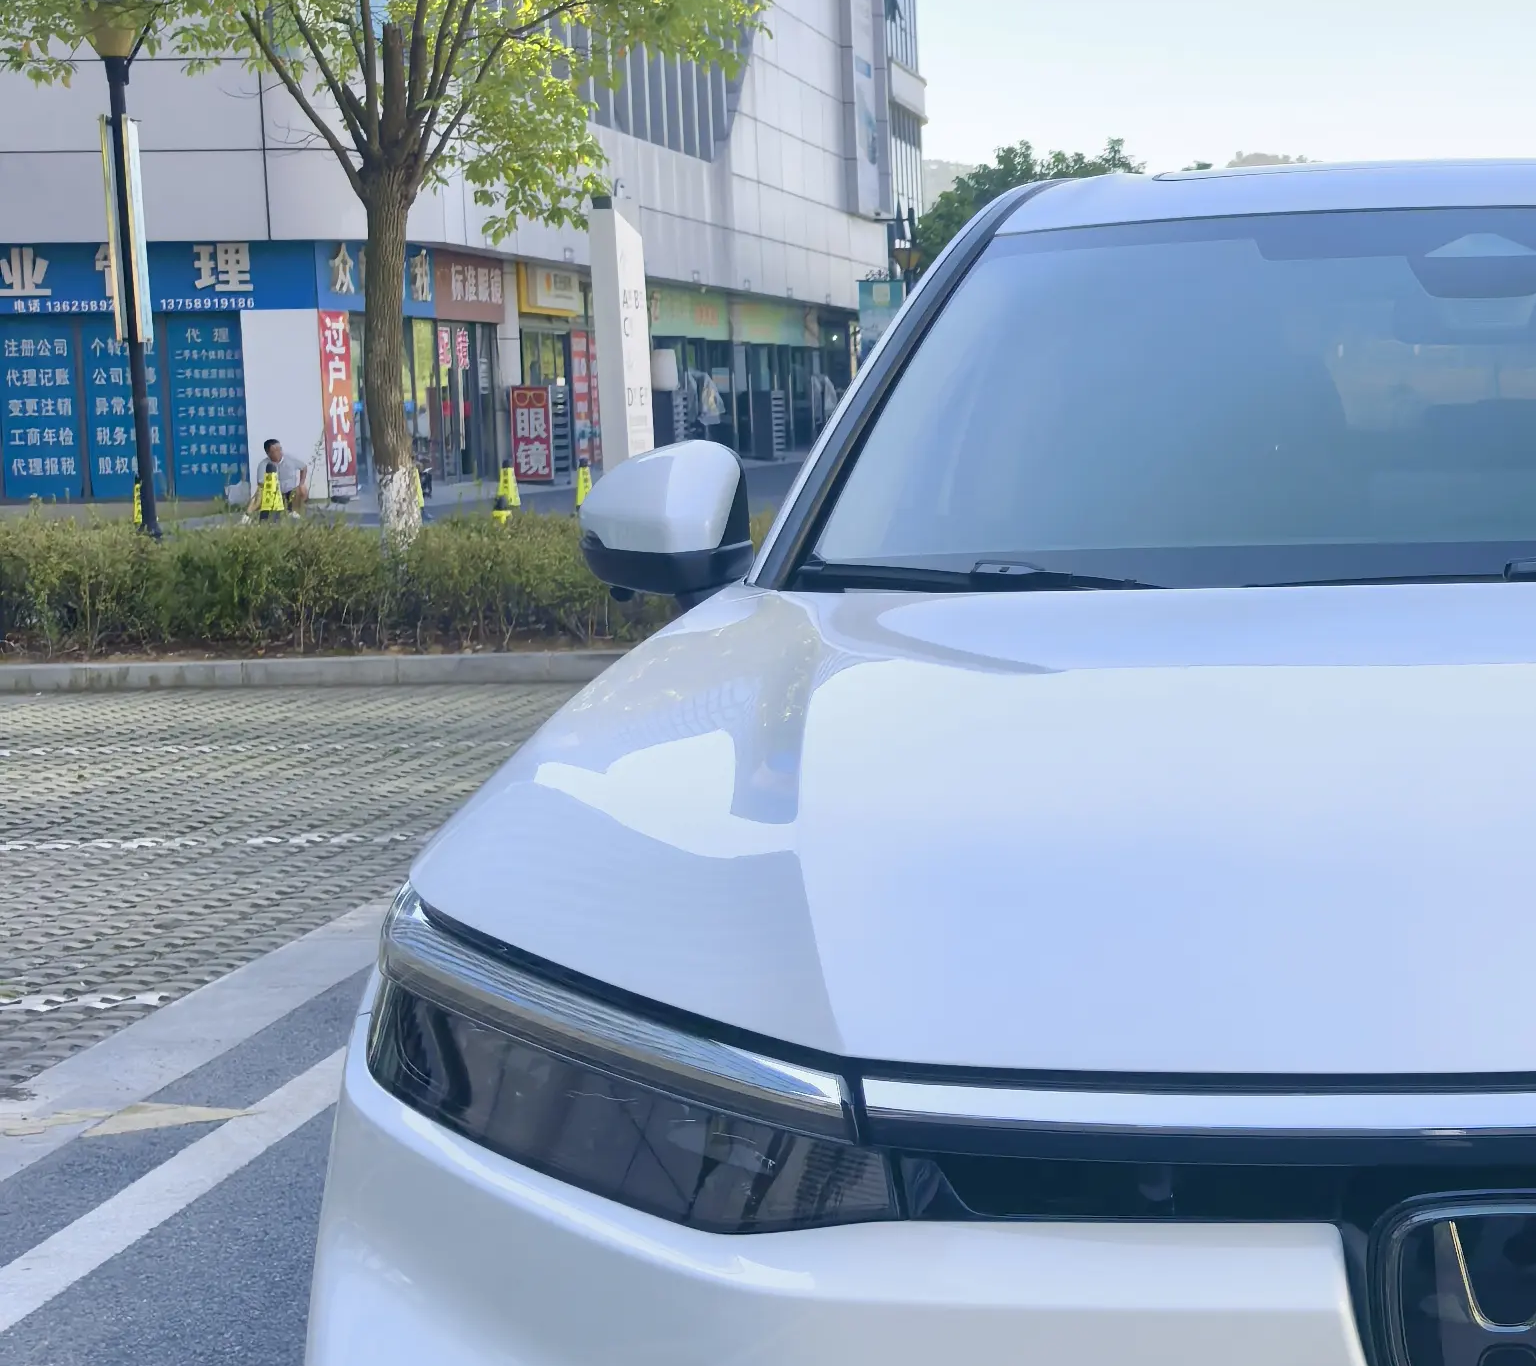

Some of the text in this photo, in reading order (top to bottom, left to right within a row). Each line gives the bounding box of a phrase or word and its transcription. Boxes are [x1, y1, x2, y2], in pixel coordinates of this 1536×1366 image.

[13, 299, 41, 313] 电话
[4, 338, 67, 357] 注册公司
[7, 368, 70, 387] 代理记账
[325, 315, 353, 474] 过户代办
[9, 398, 72, 416] 变更注销
[10, 427, 74, 446] 工商年检
[515, 407, 549, 475] 眼镜
[12, 456, 76, 476] 代理报税
